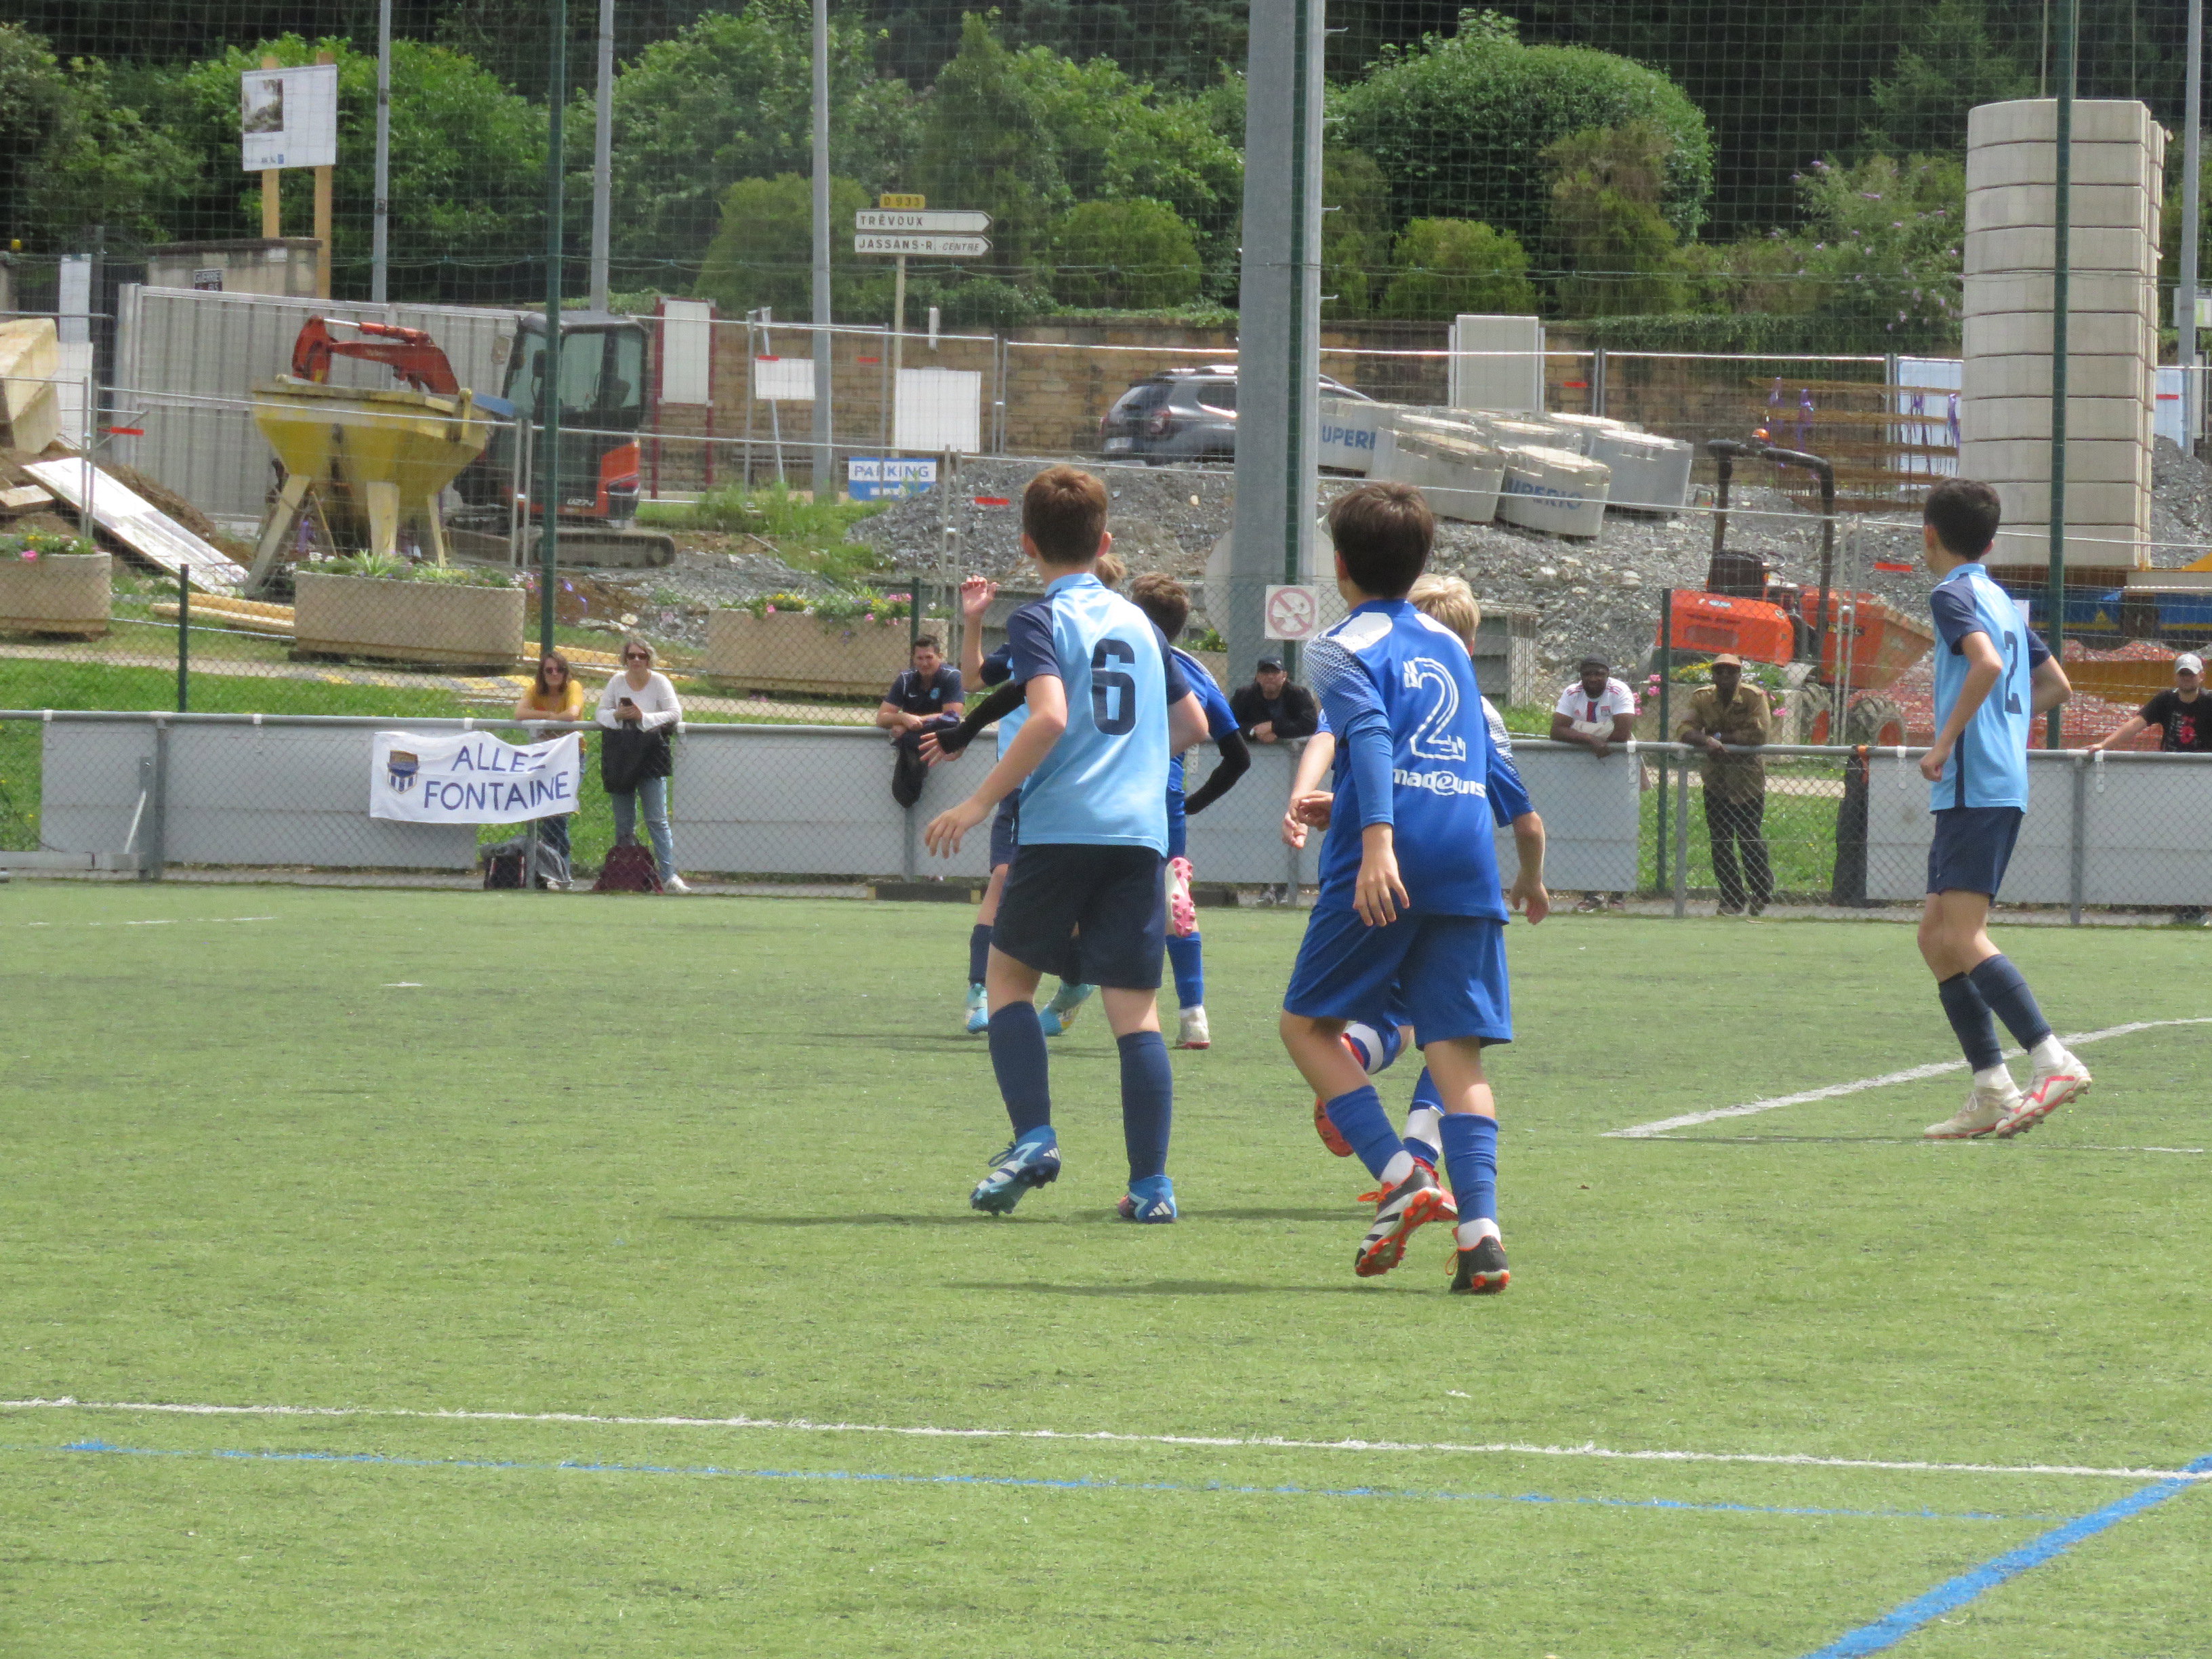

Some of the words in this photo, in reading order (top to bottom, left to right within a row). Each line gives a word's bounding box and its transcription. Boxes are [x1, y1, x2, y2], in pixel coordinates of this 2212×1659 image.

[860, 214, 923, 226] TRÉVOUX
[1091, 638, 1136, 735] 6
[2004, 630, 2022, 715] 2
[1403, 657, 1467, 762] 2
[451, 743, 548, 772] ALLEZ
[424, 771, 571, 811] FONTAINE
